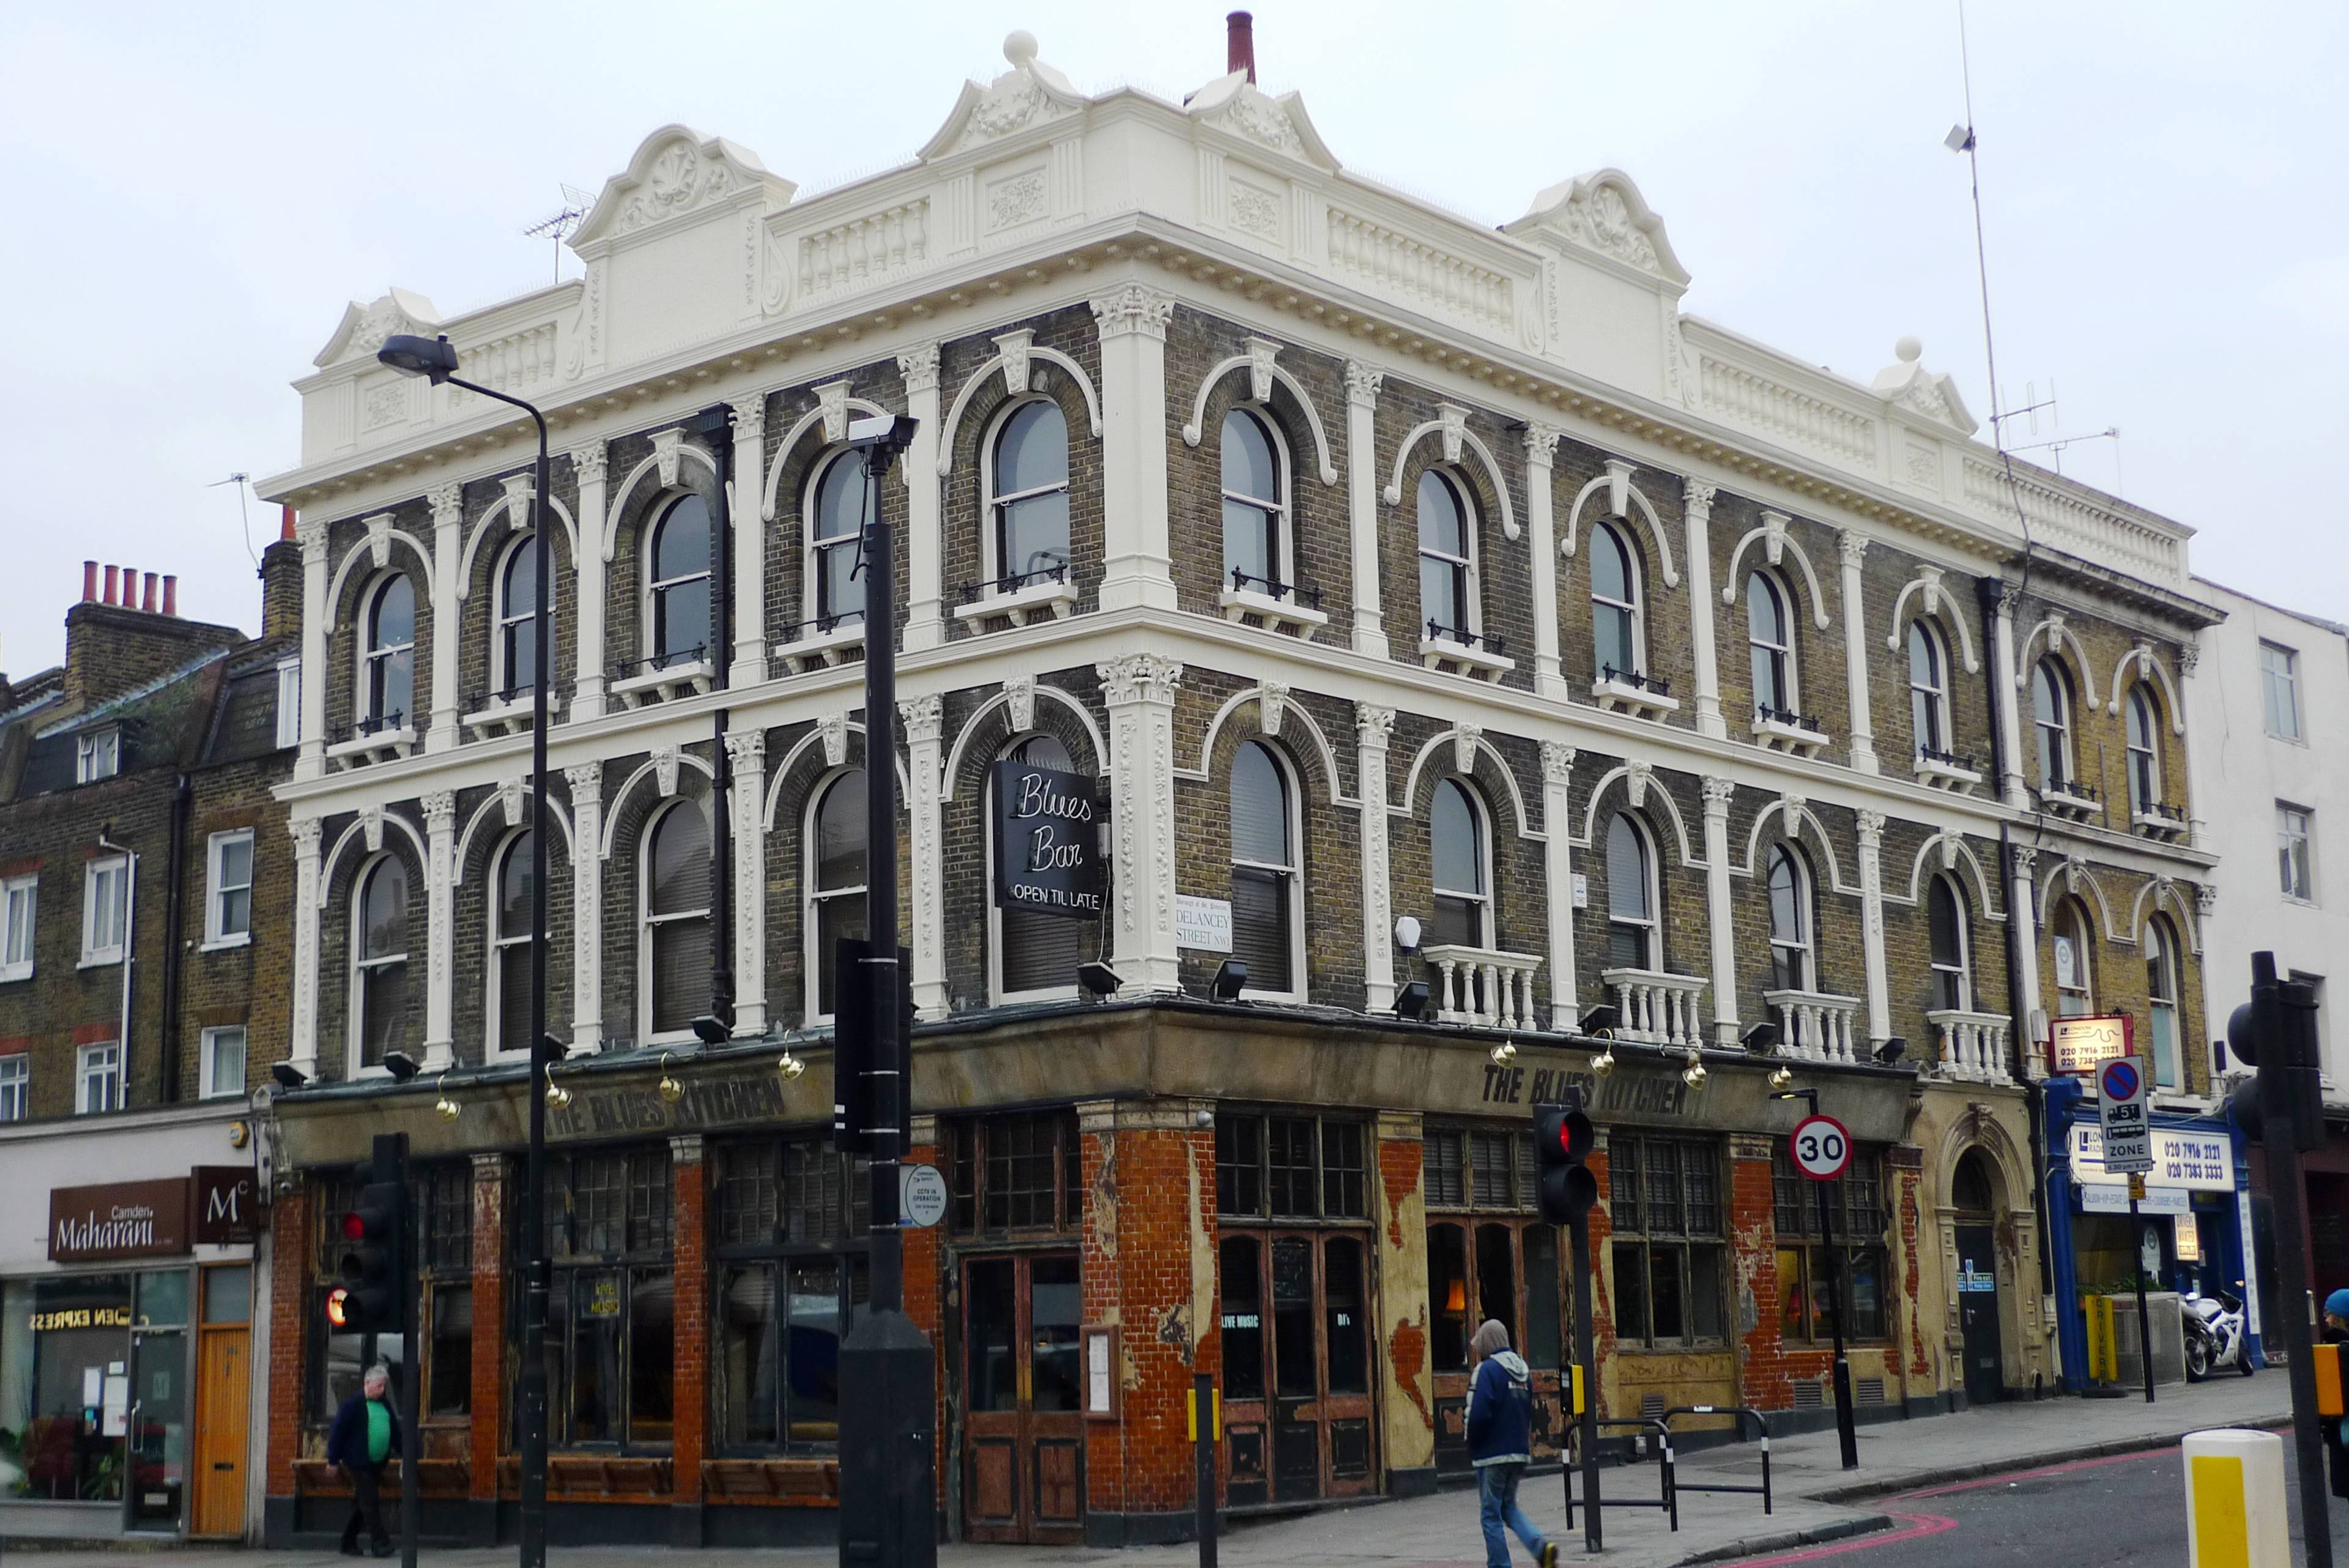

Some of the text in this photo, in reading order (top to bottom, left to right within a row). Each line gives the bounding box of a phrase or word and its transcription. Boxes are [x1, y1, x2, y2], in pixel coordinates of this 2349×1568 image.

[1018, 773, 1091, 820] Blues
[1032, 825, 1083, 871] Bar
[1014, 884, 1100, 910] OPEN TIL LATE
[1176, 909, 1230, 929] DELANCEY
[1176, 927, 1211, 945] STREET
[2102, 1045, 2118, 1053] 2121
[1483, 1064, 1524, 1104] THE
[1600, 1074, 1687, 1115] KITCHEN
[591, 1091, 666, 1131] BLUES
[674, 1077, 784, 1128] KITCHEN
[1799, 1134, 1843, 1162] 30
[2109, 1145, 2144, 1156] ZONE
[2164, 1141, 2221, 1160] 020 7916 2121
[2167, 1162, 2223, 1180] 020 7383 3333
[111, 1205, 149, 1221] Camden
[56, 1209, 153, 1252] Maharani
[1221, 1315, 1259, 1328] LIVE MUSIC
